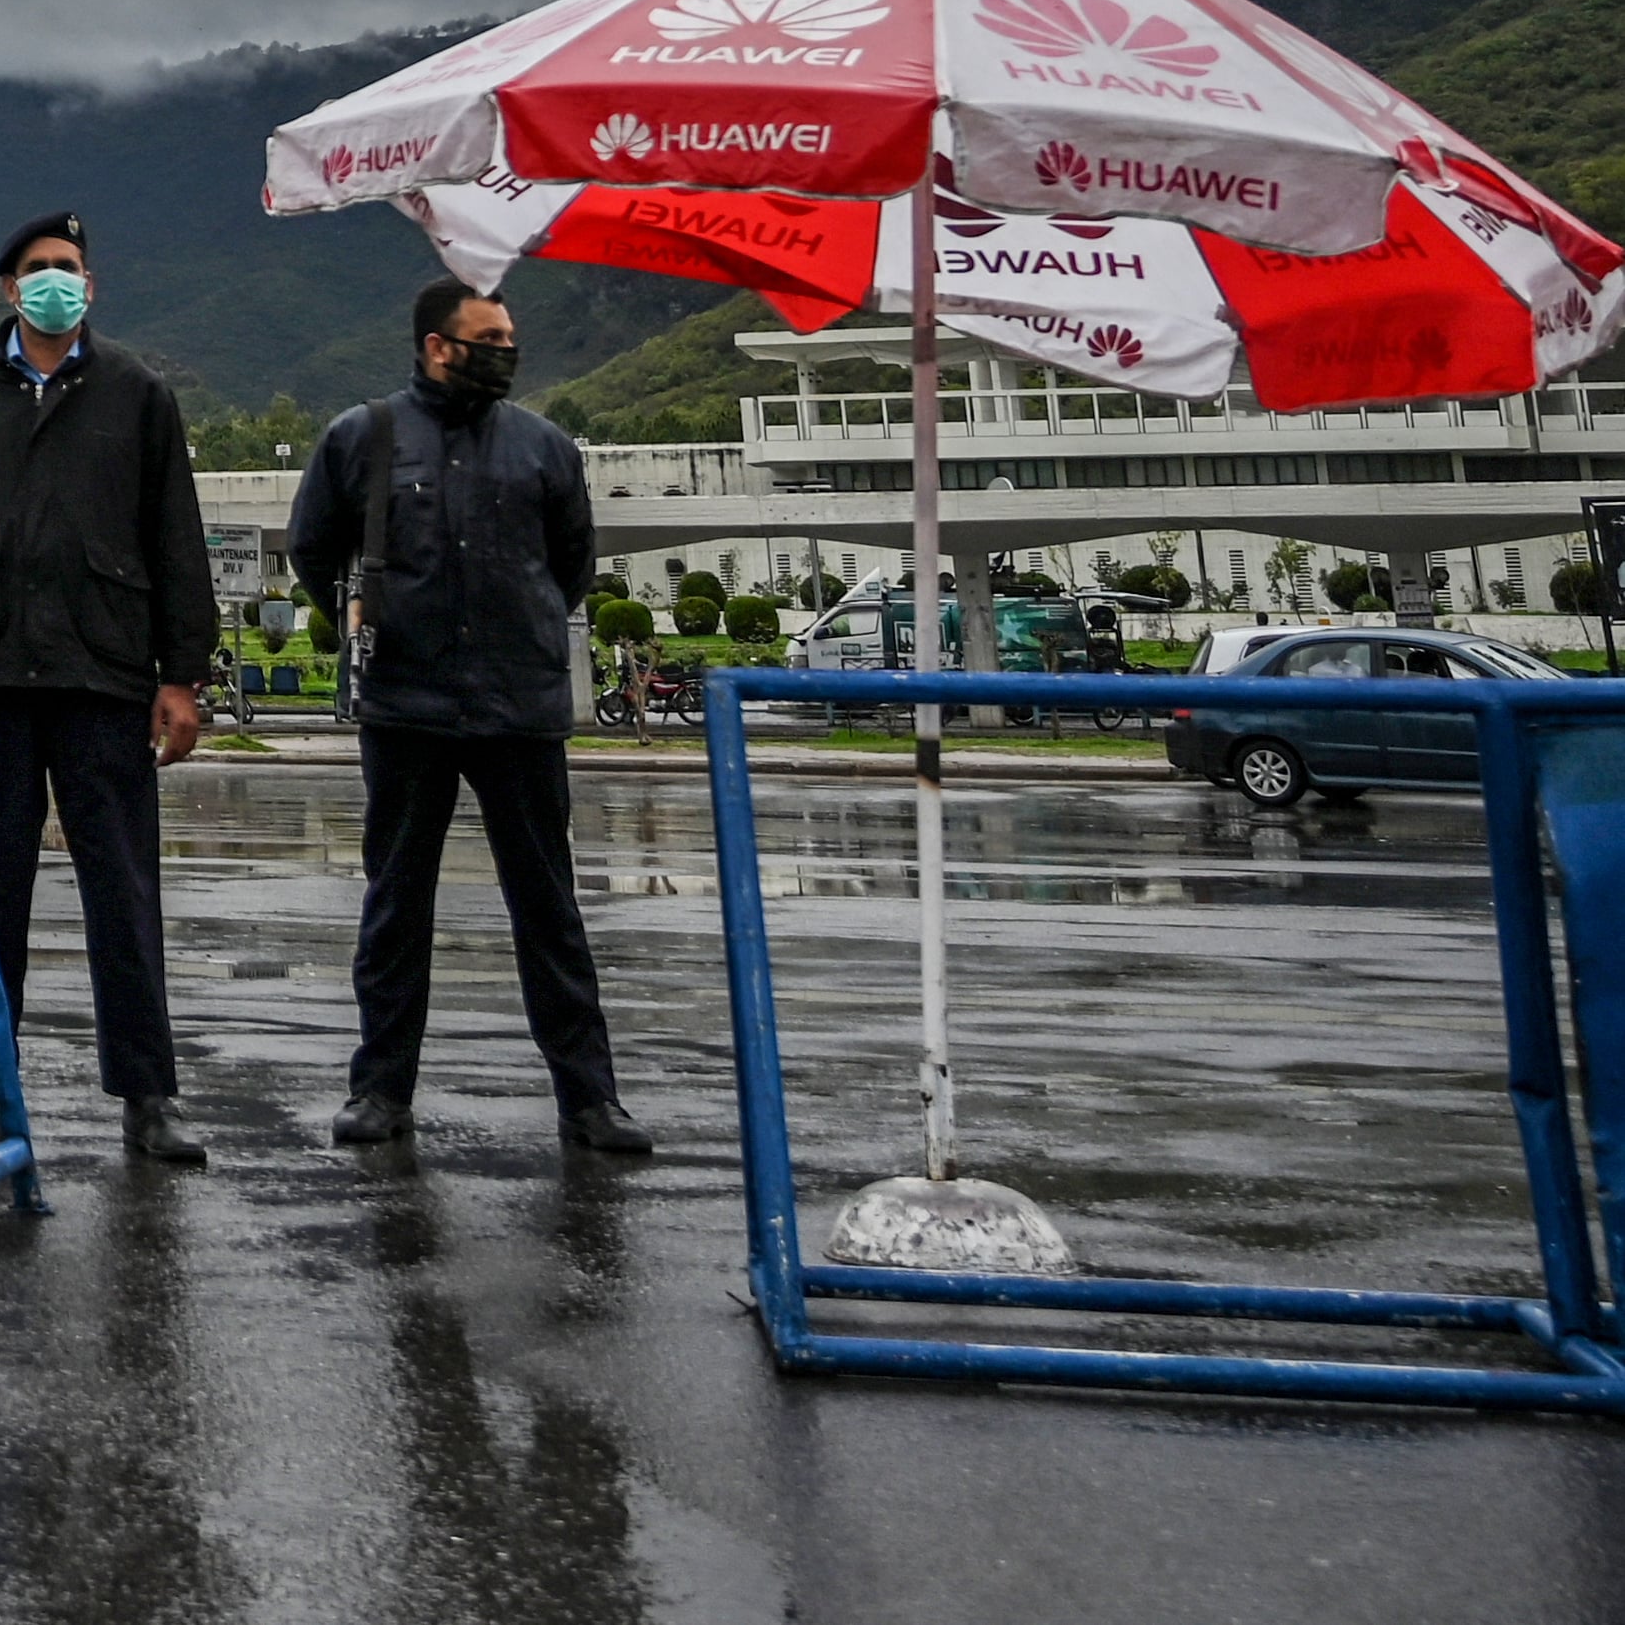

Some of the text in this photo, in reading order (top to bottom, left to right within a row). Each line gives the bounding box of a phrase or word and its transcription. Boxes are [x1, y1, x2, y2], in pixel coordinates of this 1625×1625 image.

[609, 45, 864, 68] HUAWEI
[1002, 59, 1264, 113] HUAWEI
[660, 122, 833, 154] HUAWEI
[1099, 157, 1281, 212] HUAWEI
